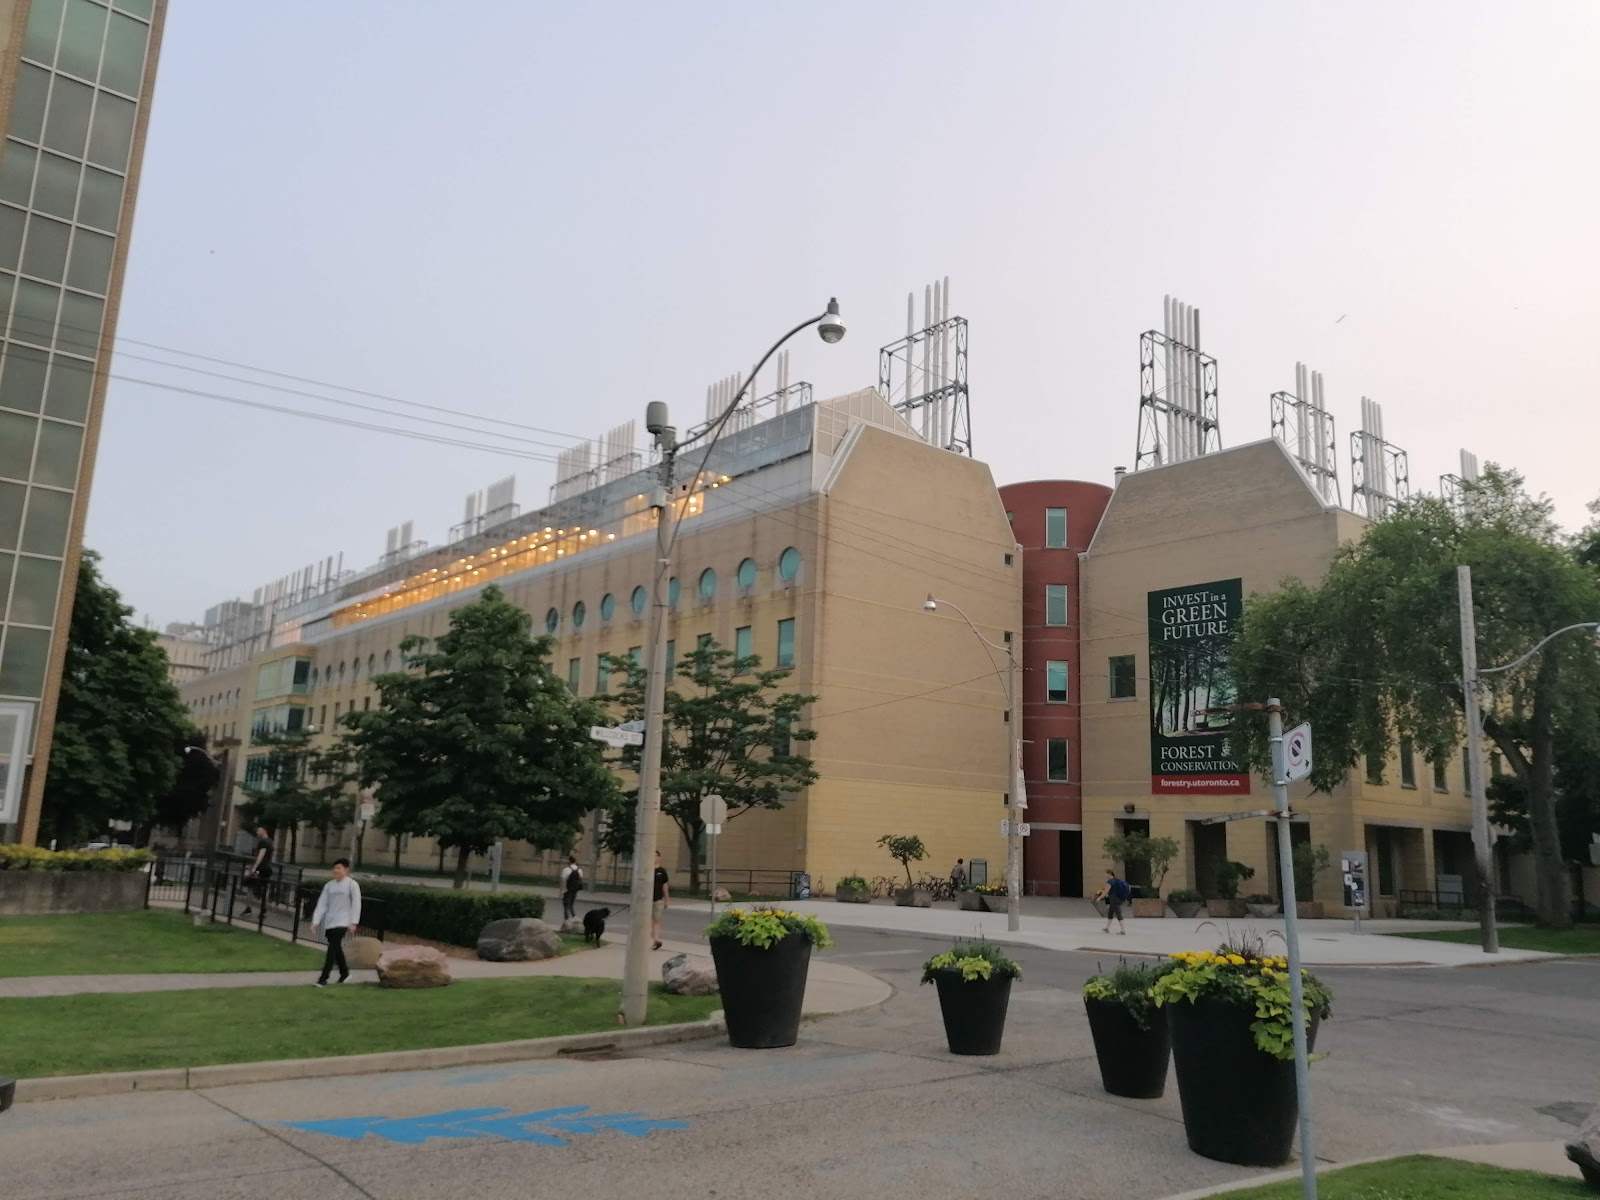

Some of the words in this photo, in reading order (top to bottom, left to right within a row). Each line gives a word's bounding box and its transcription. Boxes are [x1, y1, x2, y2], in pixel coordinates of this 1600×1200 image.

[1163, 591, 1209, 608] INVEST
[1210, 593, 1219, 602] in
[1162, 602, 1227, 625] GREEN
[1163, 620, 1229, 640] FUTURE
[1160, 745, 1215, 759] FOREST
[1160, 760, 1239, 771] CONSERVATION
[1160, 779, 1240, 788] forestry.utoronto.ca
